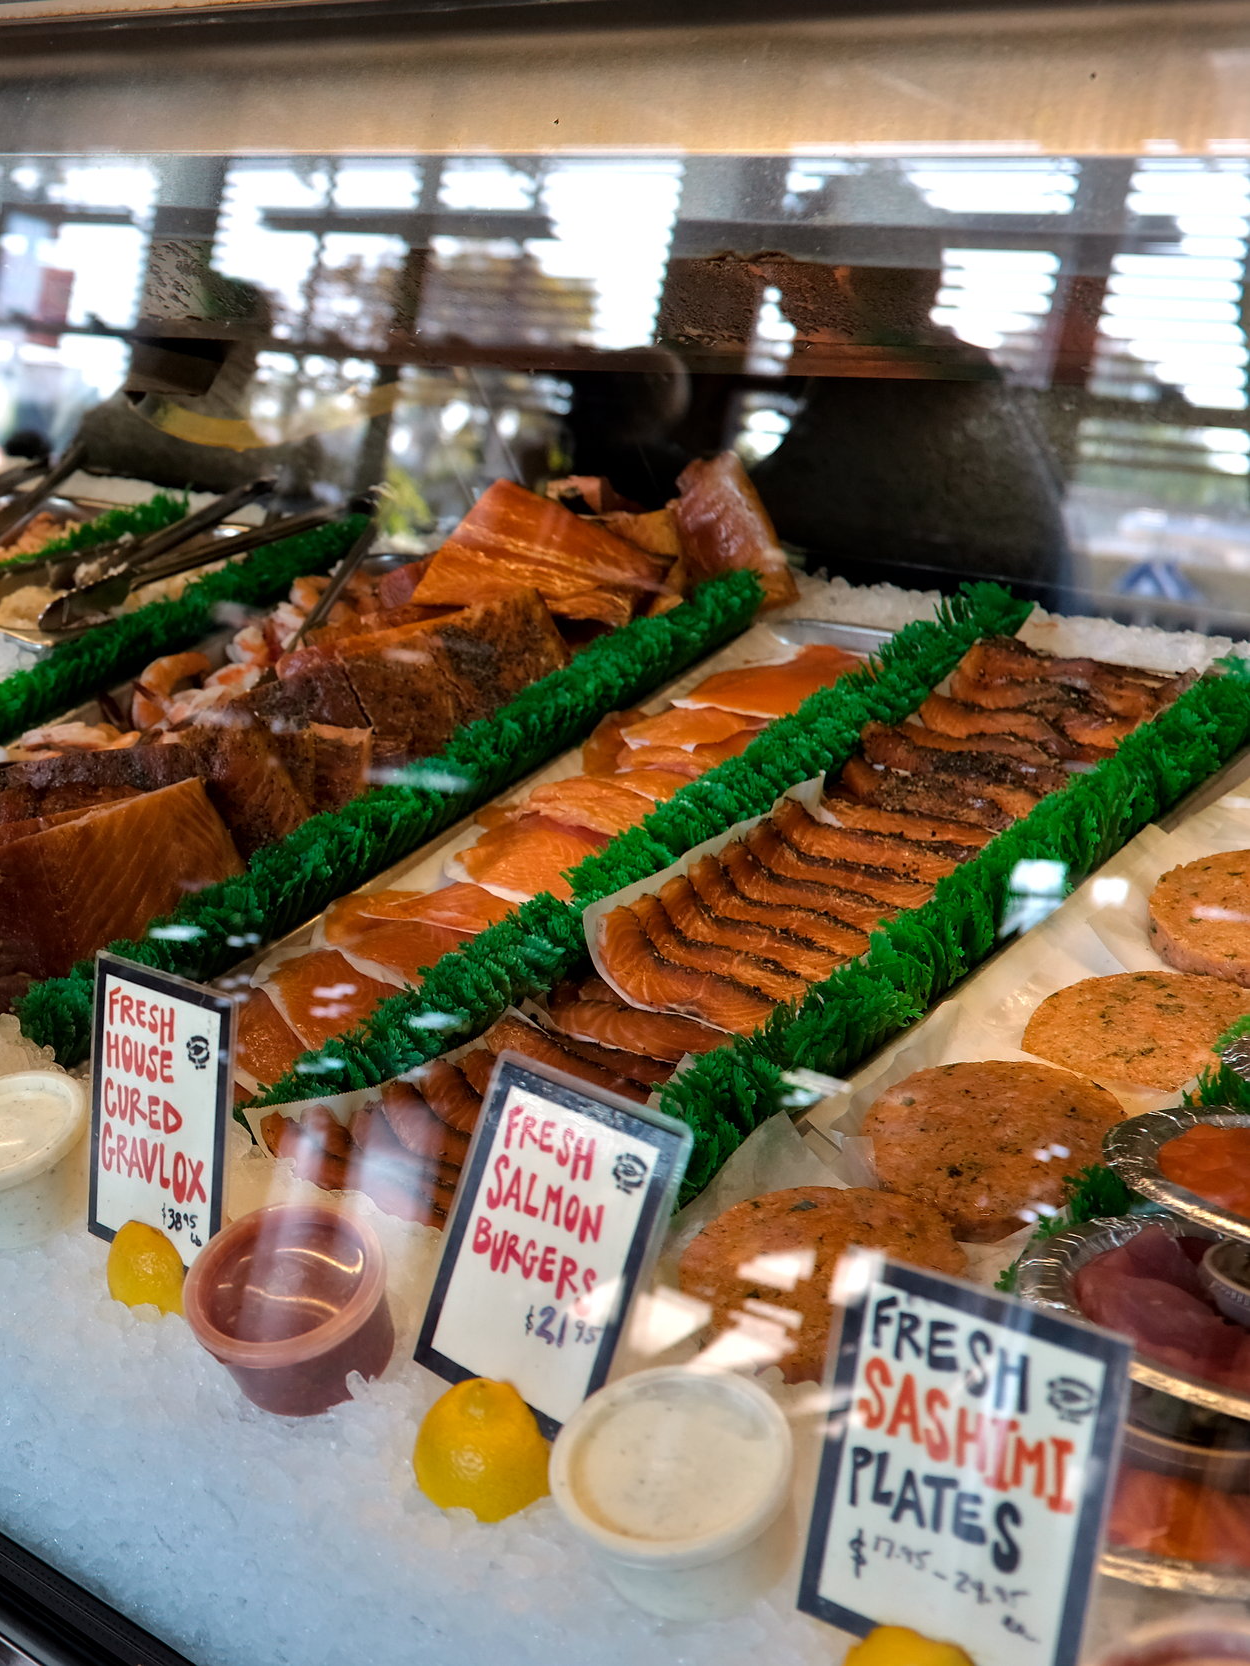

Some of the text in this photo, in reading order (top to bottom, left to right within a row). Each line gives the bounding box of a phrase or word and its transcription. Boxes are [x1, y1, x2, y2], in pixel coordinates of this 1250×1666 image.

[106, 1030, 174, 1083] HOUSE
[109, 986, 175, 1046] FRESH
[104, 1077, 183, 1134] CURED
[503, 1105, 596, 1181] FRESH
[101, 1122, 207, 1204] GRAVLOX
[486, 1154, 605, 1243] SALMON
[472, 1215, 598, 1316] BURGERS
[871, 1296, 1030, 1413] FRESH
[859, 1357, 1074, 1513] SASHIMI
[849, 1447, 1022, 1574] PLATES
